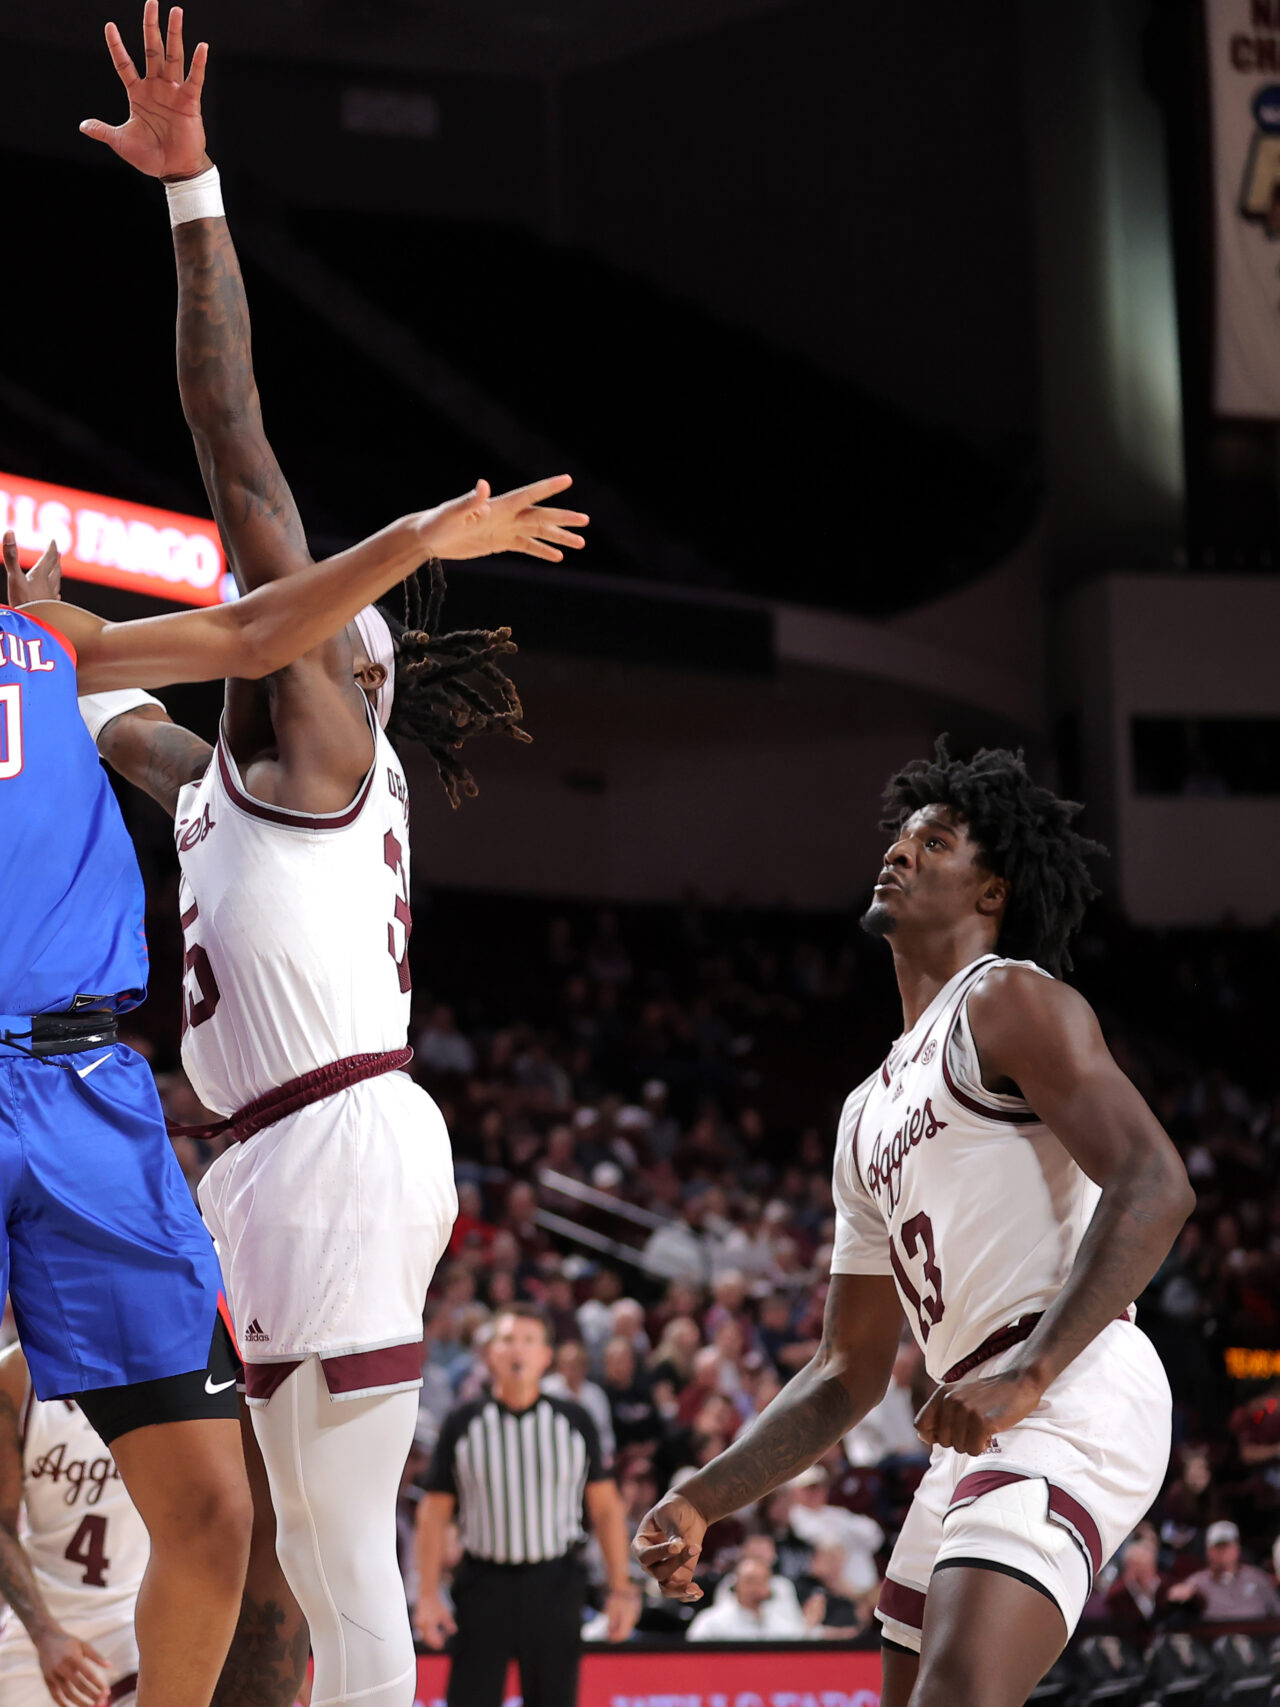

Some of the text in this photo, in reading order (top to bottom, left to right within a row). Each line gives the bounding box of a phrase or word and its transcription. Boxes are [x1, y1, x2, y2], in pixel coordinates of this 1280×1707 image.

[74, 508, 220, 589] FARGO
[867, 1097, 949, 1218] Aggies
[889, 1210, 946, 1344] 13
[64, 1514, 110, 1588] 4
